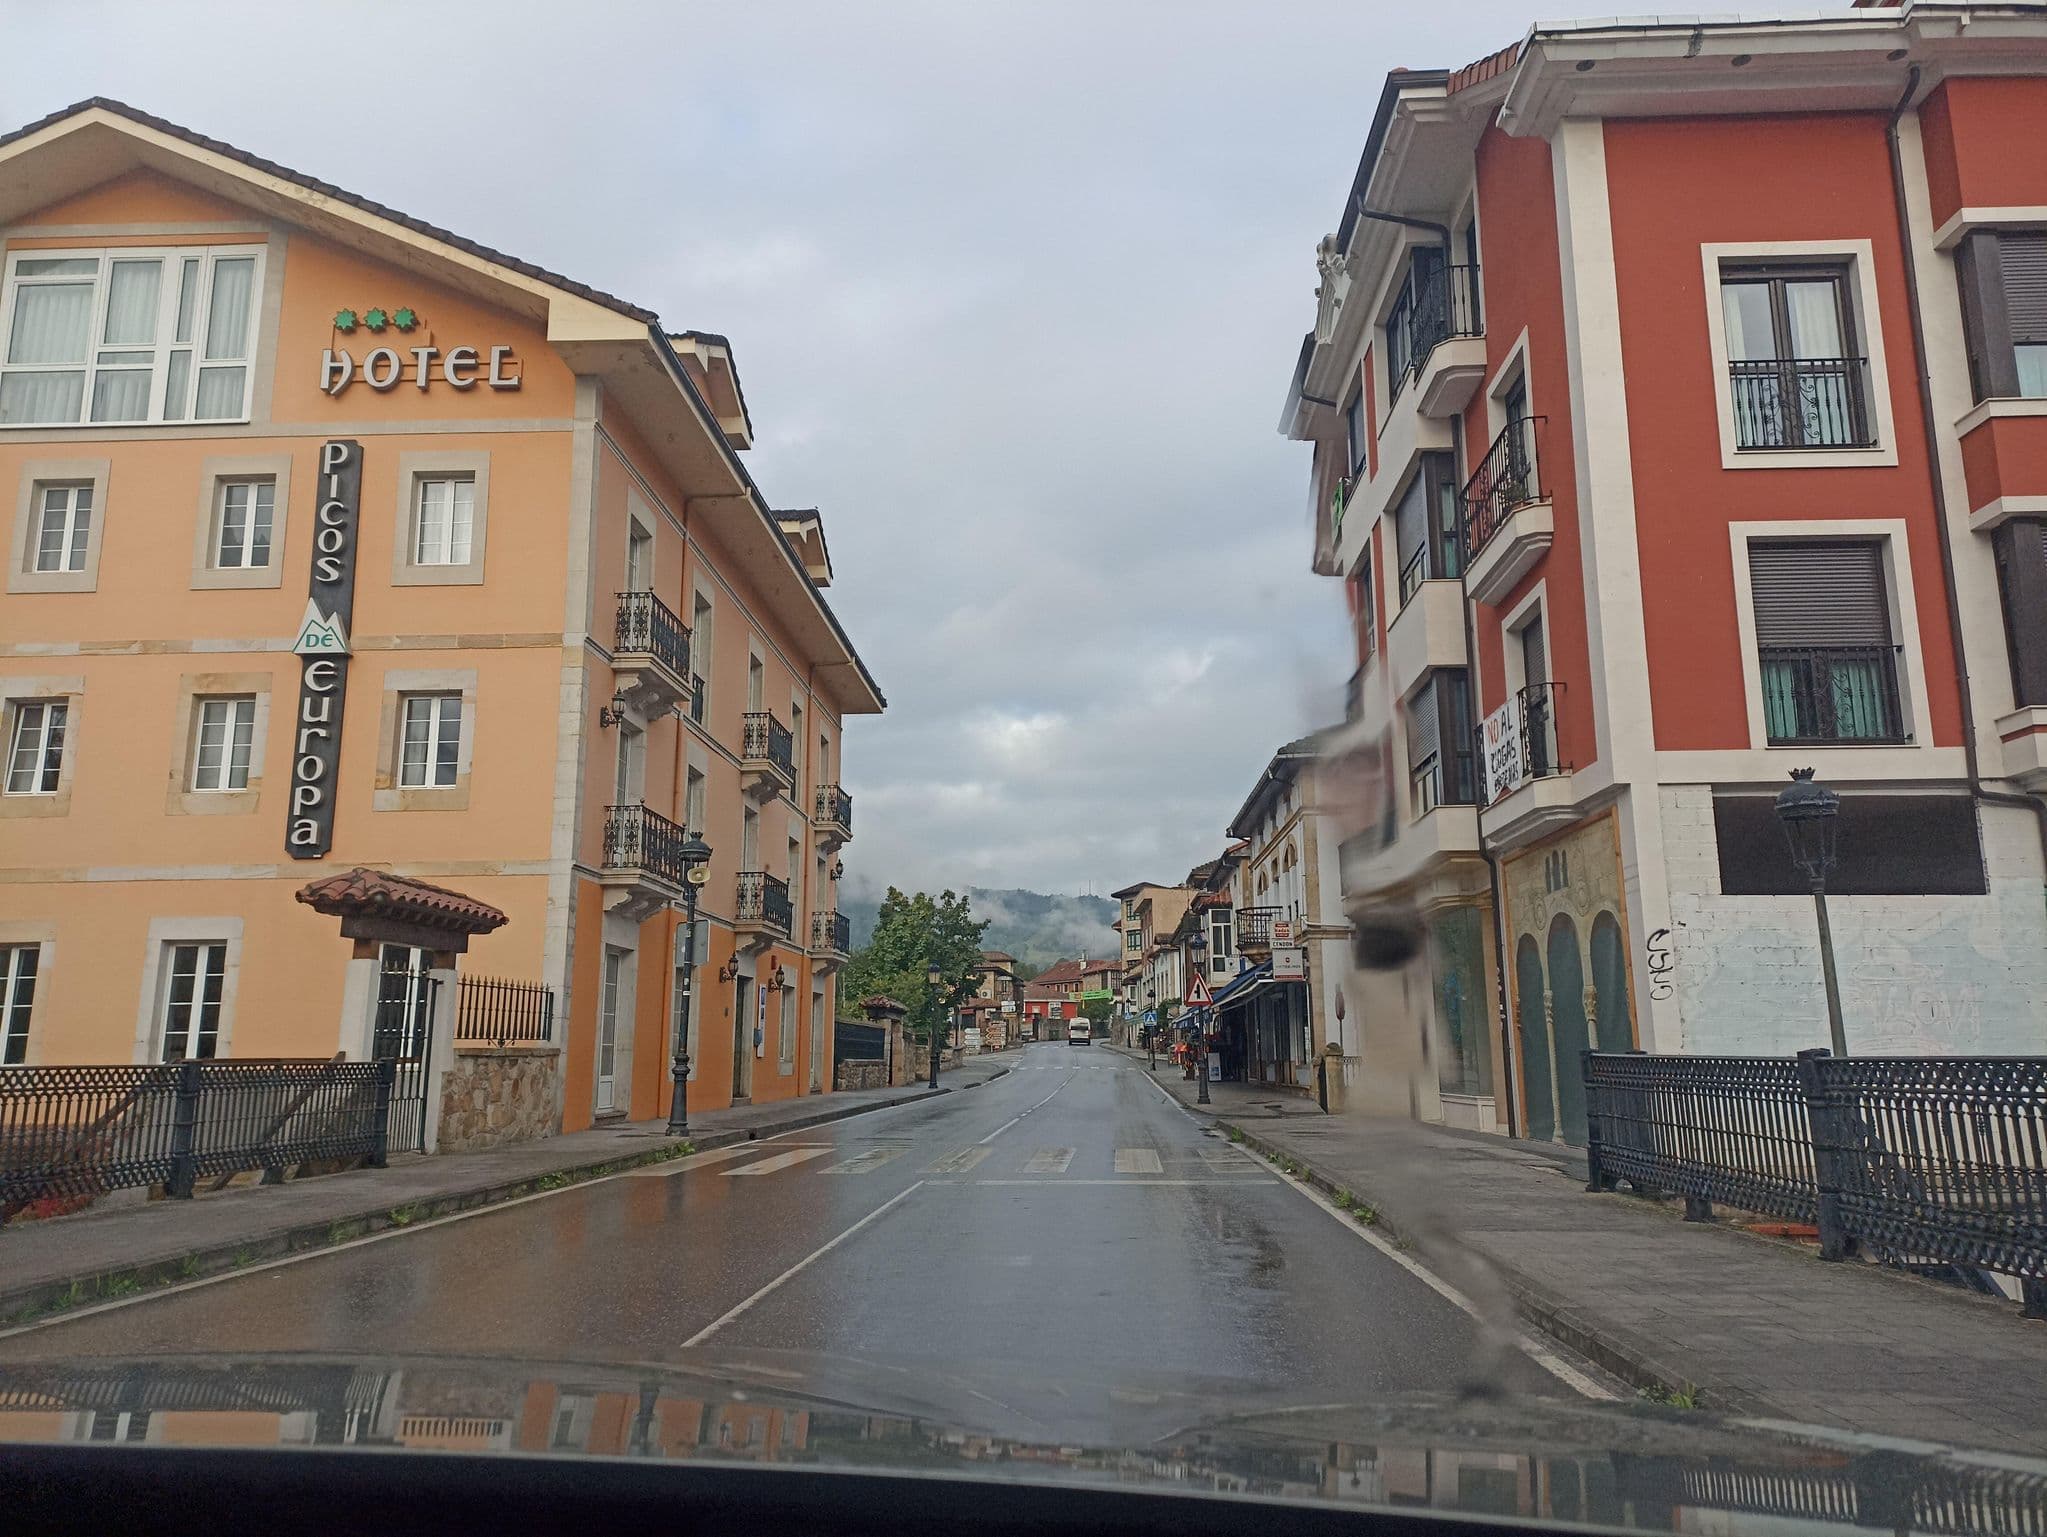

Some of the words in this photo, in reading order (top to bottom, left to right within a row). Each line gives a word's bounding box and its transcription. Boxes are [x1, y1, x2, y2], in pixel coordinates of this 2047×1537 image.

[321, 345, 521, 395] HOTEL
[315, 442, 349, 582] PICOS
[305, 634, 334, 648] DE
[1487, 718, 1499, 747] NO
[1501, 704, 1514, 737] AL
